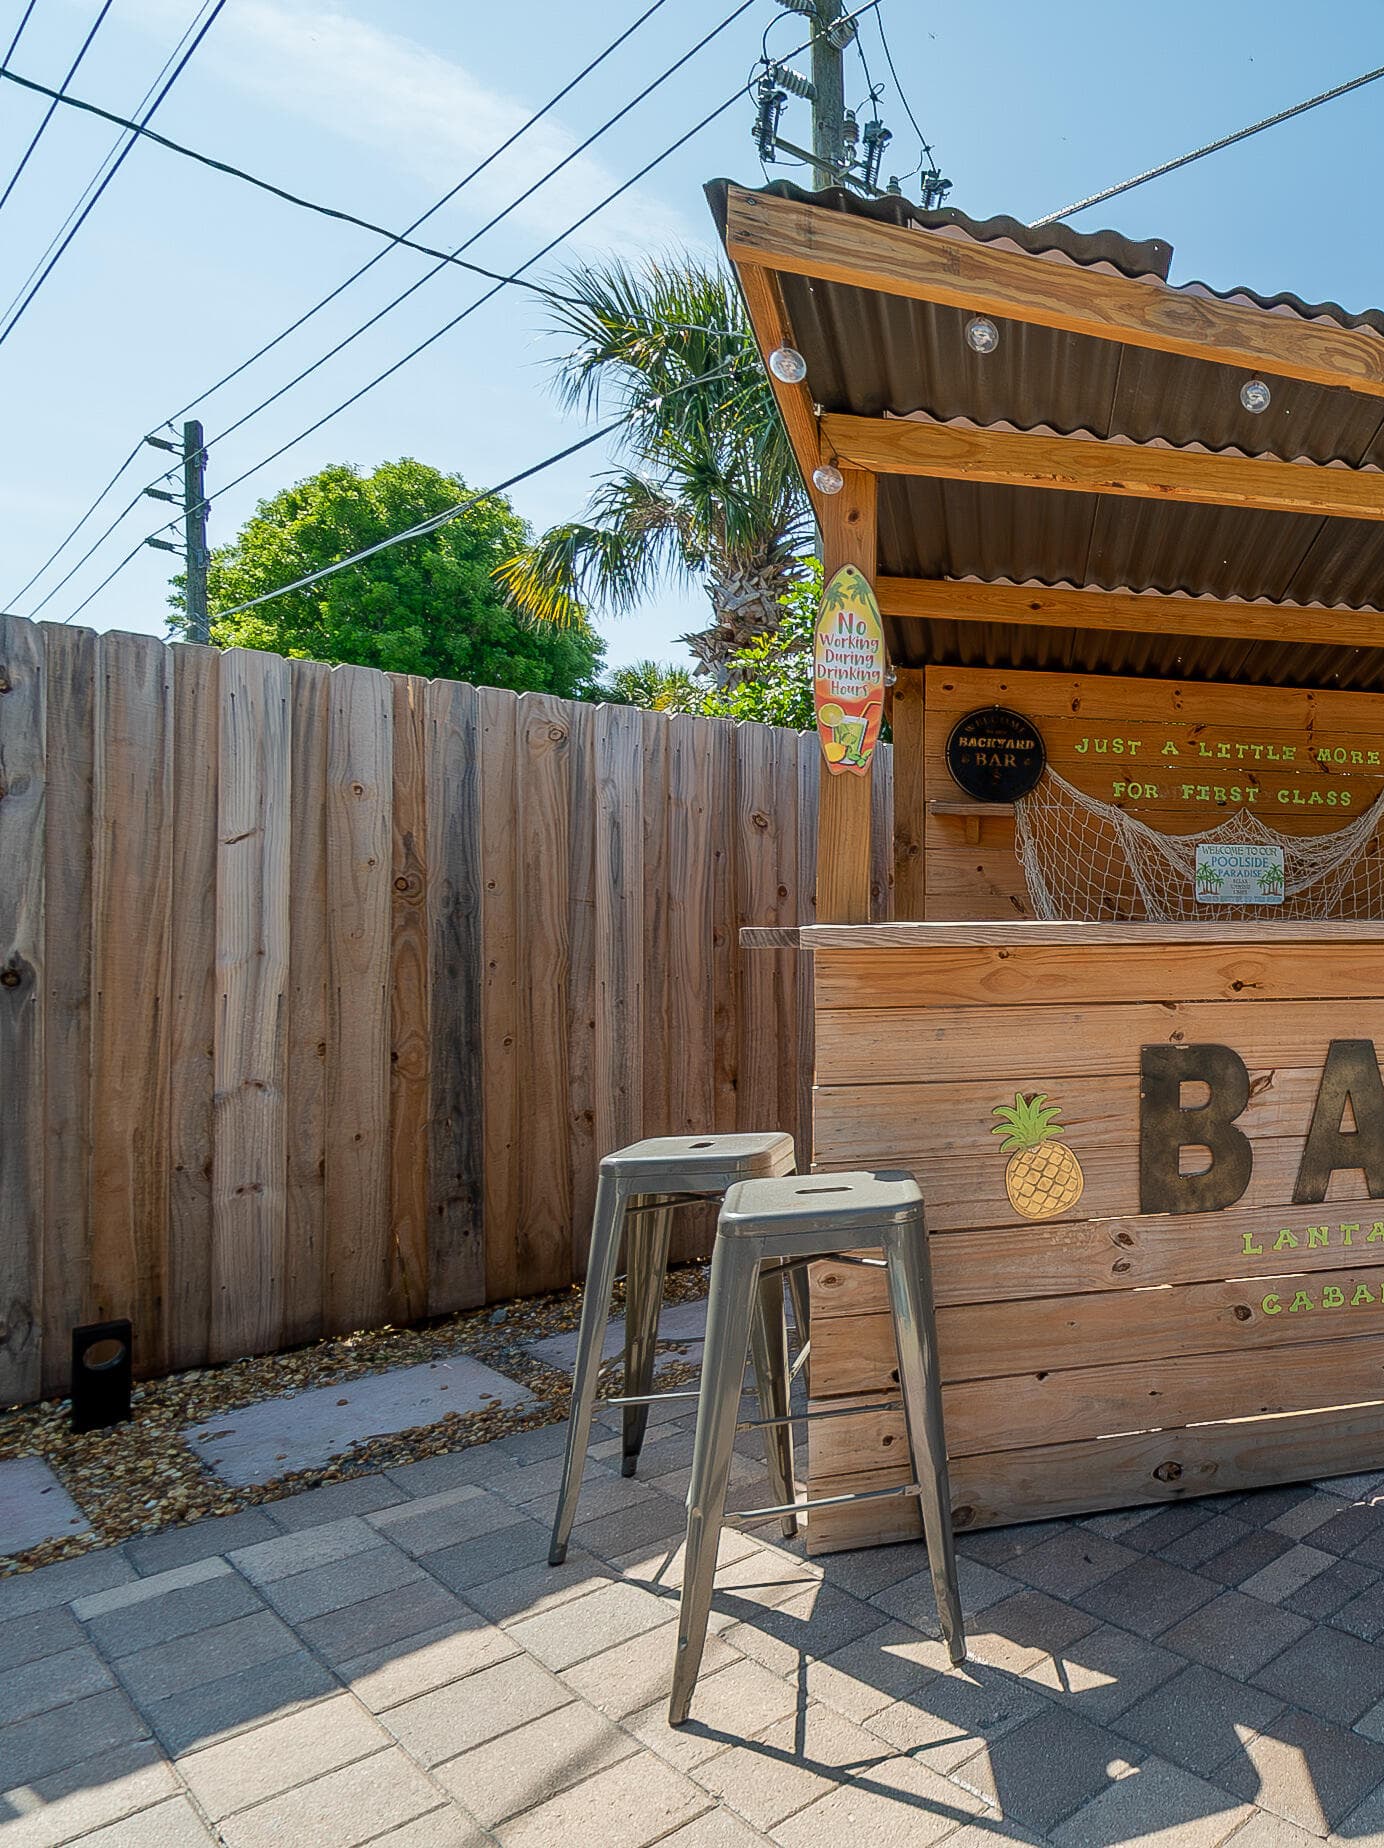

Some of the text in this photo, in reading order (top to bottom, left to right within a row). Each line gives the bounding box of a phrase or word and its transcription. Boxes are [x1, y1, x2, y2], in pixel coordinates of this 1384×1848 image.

[838, 612, 866, 635] No
[819, 633, 879, 654] Working
[825, 648, 874, 669] During
[817, 664, 881, 685] Drinking
[831, 681, 868, 696] Hours
[959, 737, 1034, 749] BACKYARD
[1074, 738, 1380, 765] JUST A LITTLE MORE
[975, 752, 1017, 768] BAR
[1112, 782, 1352, 807] FOR FIRST CLASS
[1202, 846, 1277, 857] WELCOME TO OUR
[1211, 856, 1269, 868] POOLSIDE
[1218, 869, 1262, 878] PARADISE
